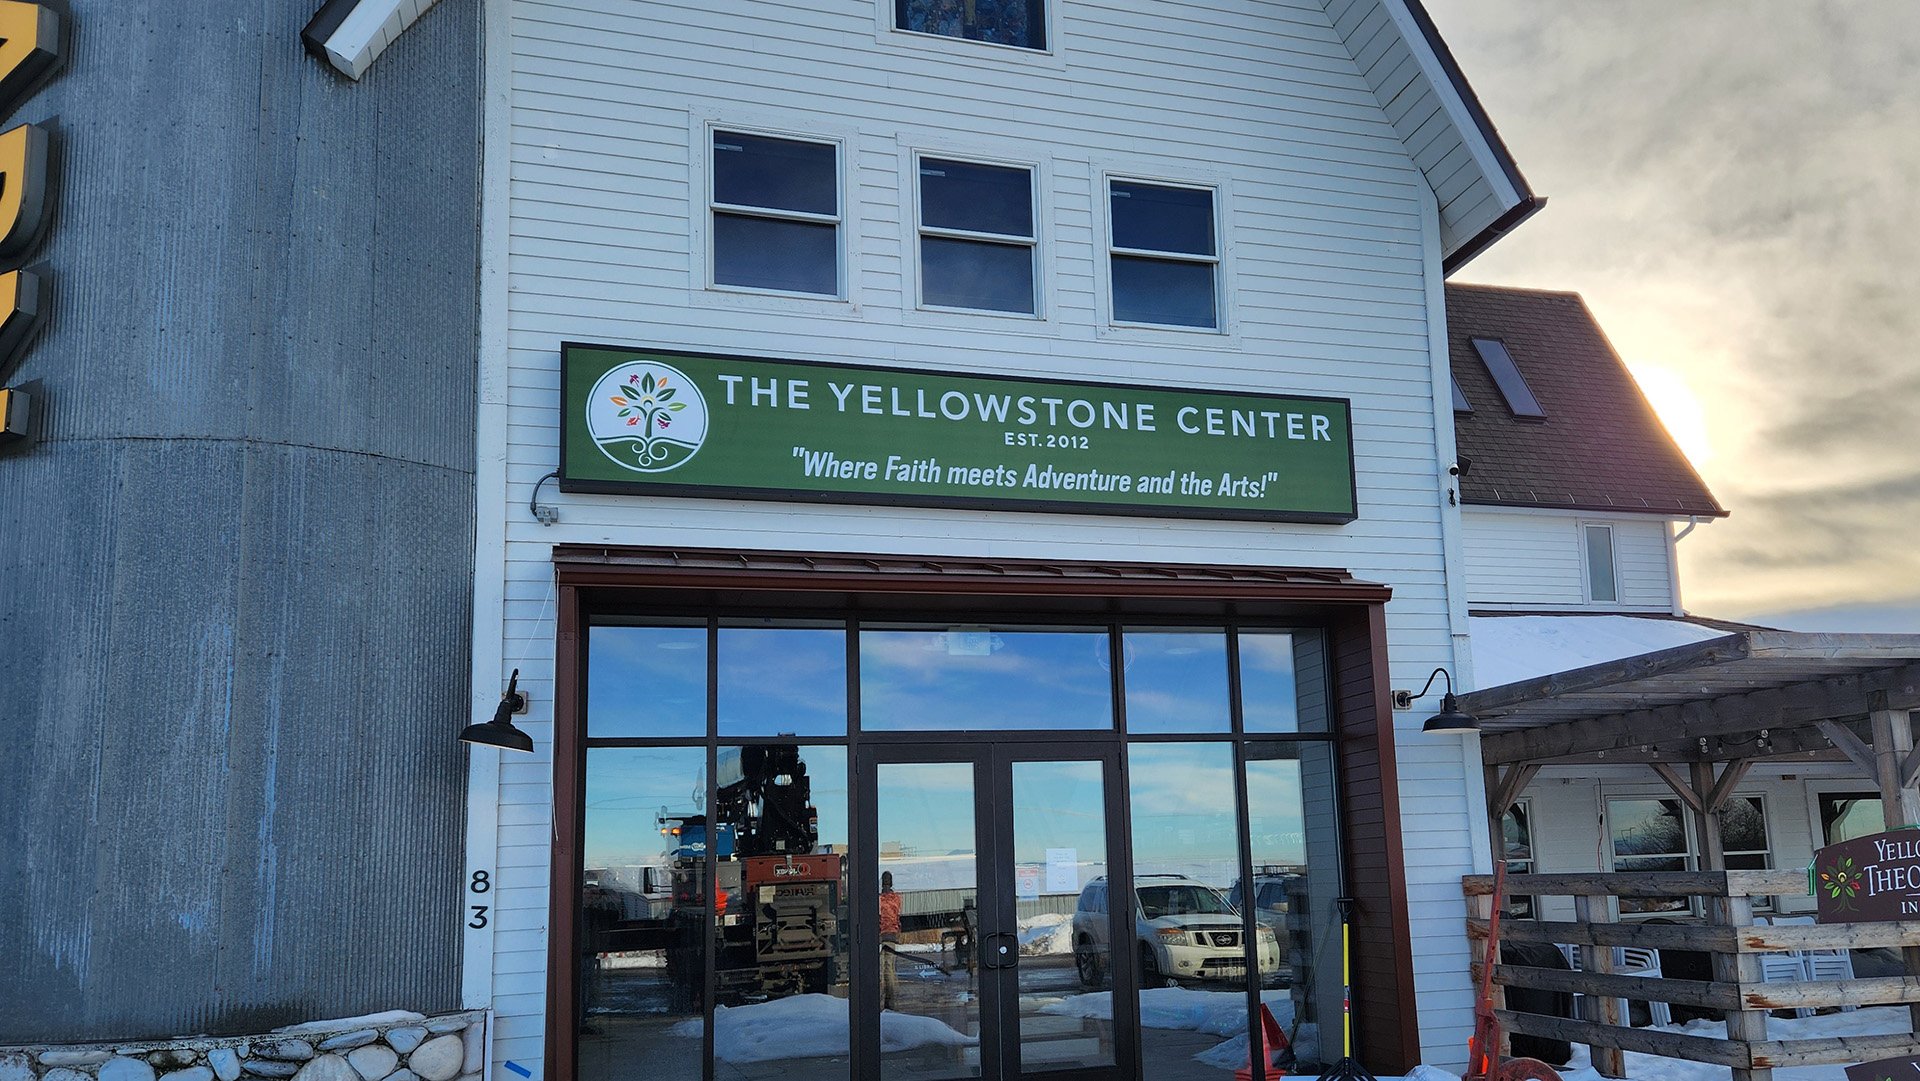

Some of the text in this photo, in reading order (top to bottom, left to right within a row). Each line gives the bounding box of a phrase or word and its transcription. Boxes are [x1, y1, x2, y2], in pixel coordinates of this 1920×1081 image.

[718, 374, 1332, 442] THE YELLOWSTONE CENTER
[791, 446, 1279, 498] "Where Faith meets Adventure and the Arts!"
